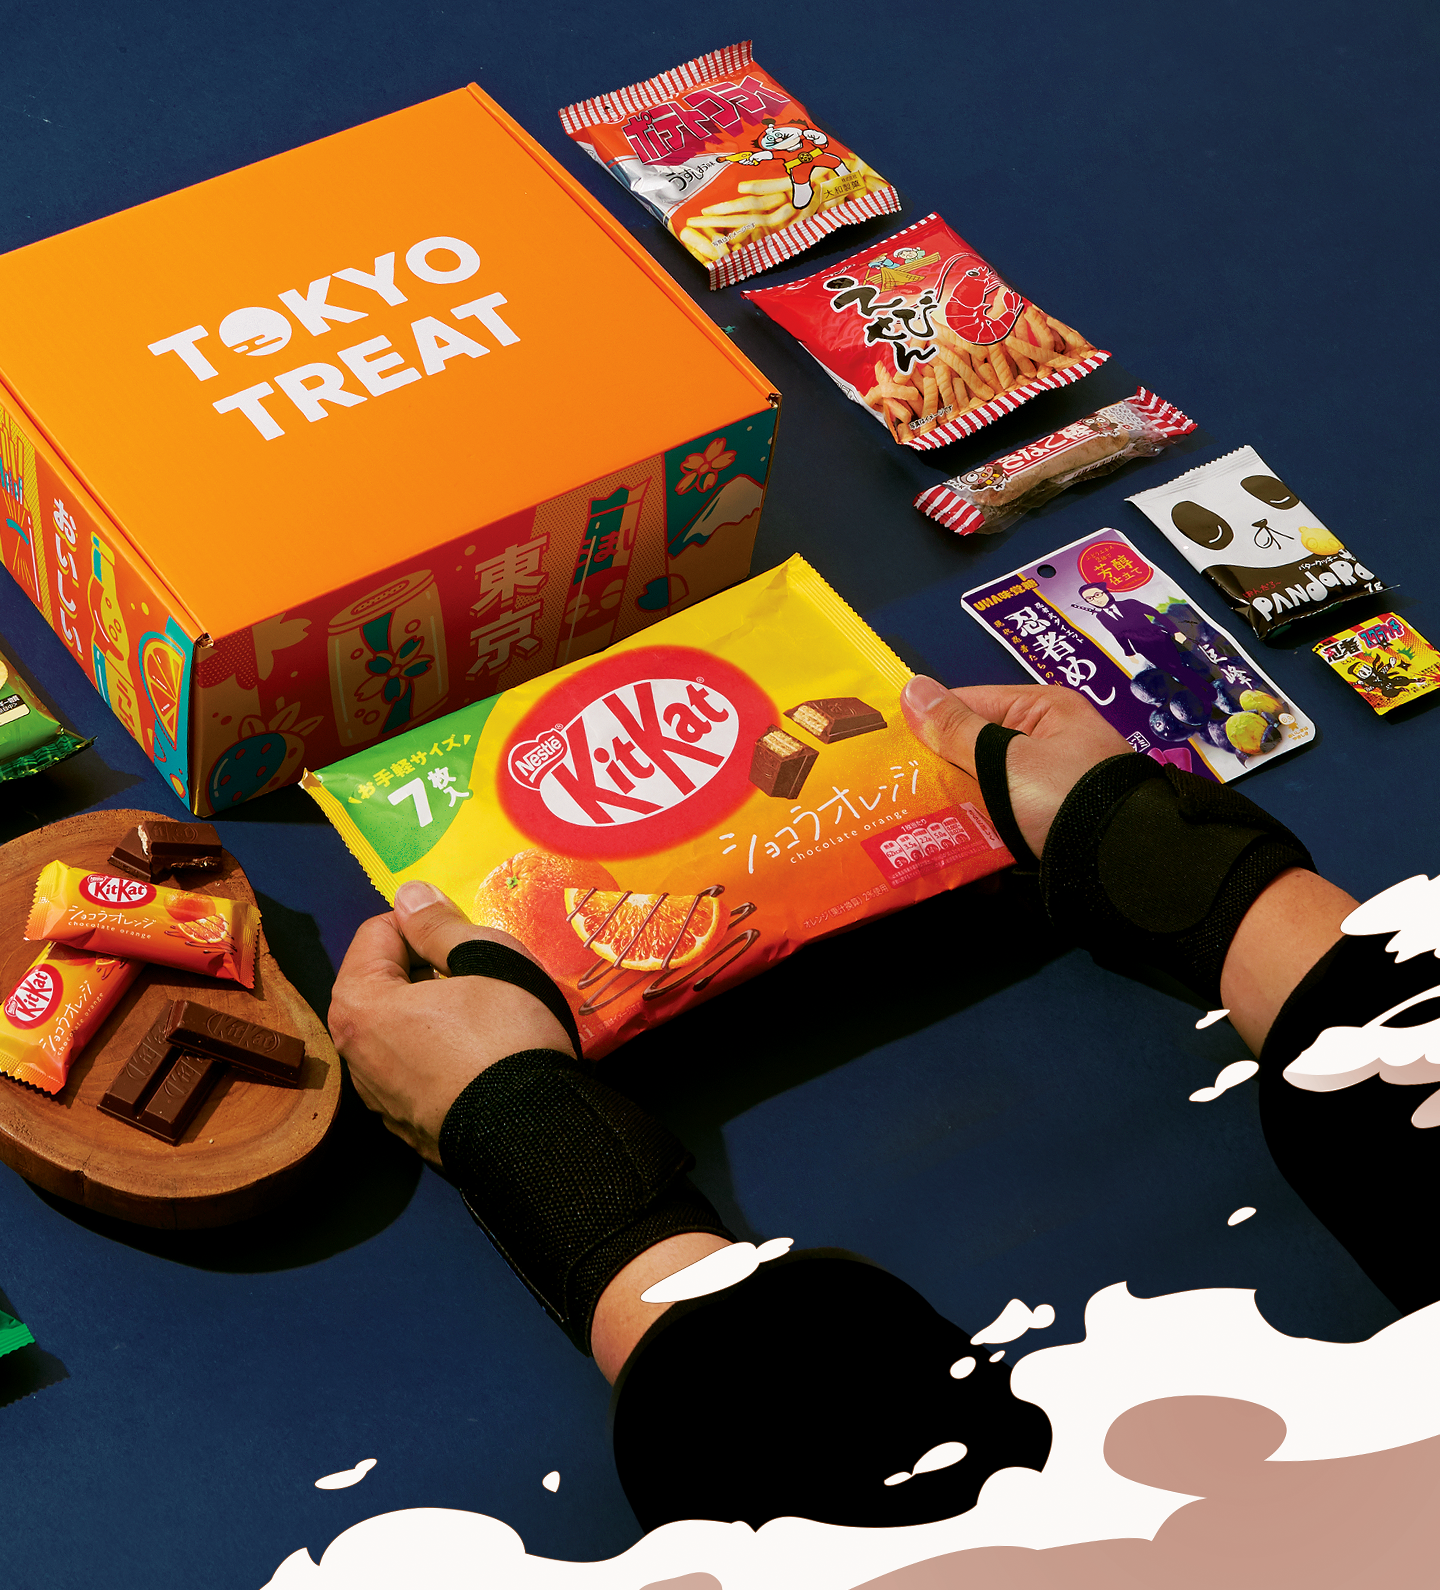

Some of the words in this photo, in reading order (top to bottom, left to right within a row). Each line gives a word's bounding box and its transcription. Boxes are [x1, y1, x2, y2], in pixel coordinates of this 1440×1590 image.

[621, 75, 790, 165] ポテトフライ
[824, 180, 861, 199] 大和製菓
[147, 234, 481, 382] TOKYO
[823, 276, 939, 375] えびせん
[212, 292, 522, 441] TREAT
[999, 422, 1093, 470] きなこ棒
[53, 499, 83, 660] おいしい
[1094, 555, 1134, 580] 芳醇
[1110, 566, 1143, 586] 仕立て
[1298, 555, 1339, 571] バタークッキー
[1364, 581, 1384, 593] 7g
[472, 540, 548, 677] 東京
[973, 579, 1038, 611] UHA味覚糖
[1004, 606, 1116, 706] 忍者めし
[1322, 636, 1361, 664] 忍者
[357, 734, 461, 800] お手軽サイズ
[515, 736, 563, 777] Nestlé
[548, 682, 731, 825] KitKat
[388, 767, 470, 827] 7枚入
[720, 759, 920, 875] ショコラオレンジ
[789, 830, 858, 865] chocolate
[864, 808, 908, 831] orange
[93, 877, 147, 903] KitKat
[68, 905, 156, 929] ショコラオレンジ
[68, 920, 115, 932] chocolate
[120, 928, 152, 940] orange
[16, 970, 53, 1021] KitKat
[39, 979, 93, 1053] ショコラオレンジ
[84, 992, 104, 1017] orange
